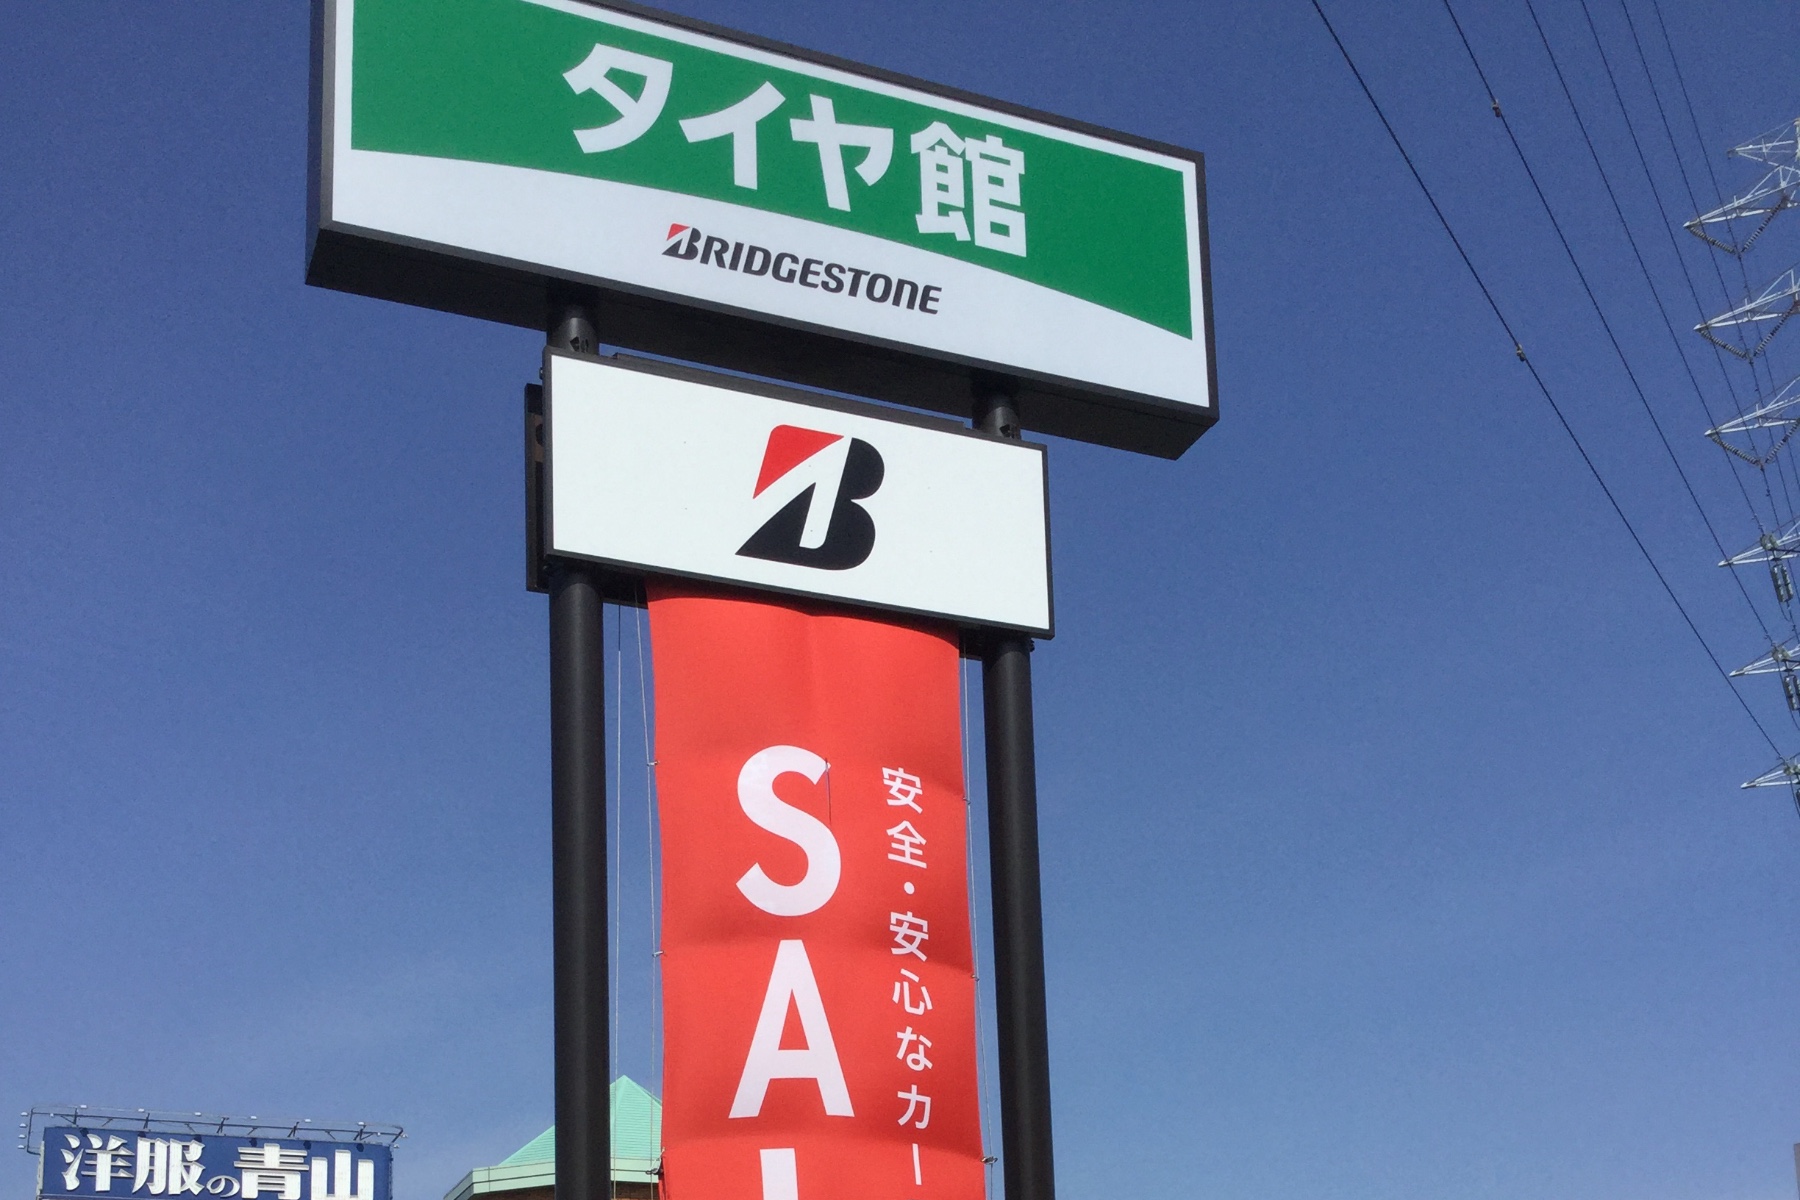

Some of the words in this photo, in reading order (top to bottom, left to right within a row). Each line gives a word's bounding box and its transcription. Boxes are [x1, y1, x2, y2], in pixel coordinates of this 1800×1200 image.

[562, 43, 1027, 257] タイヤ館
[662, 223, 943, 316] BRIDGESTONE
